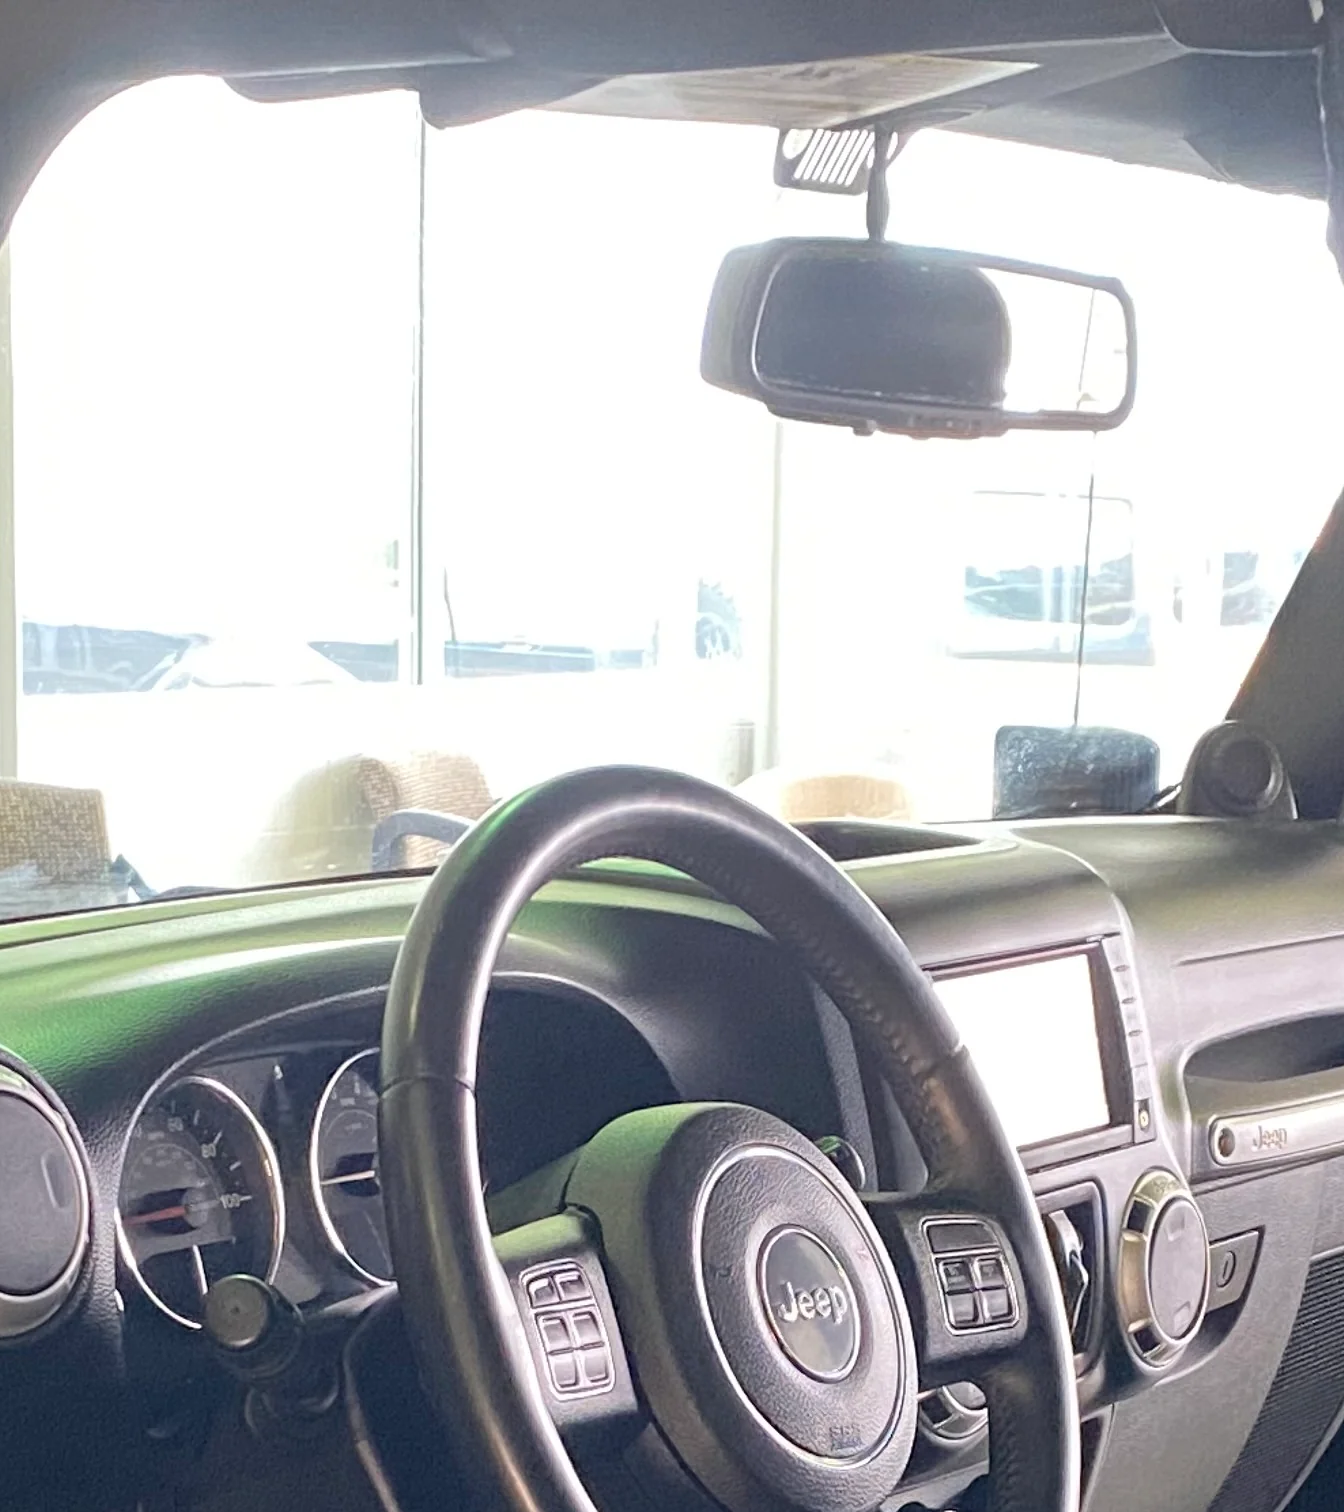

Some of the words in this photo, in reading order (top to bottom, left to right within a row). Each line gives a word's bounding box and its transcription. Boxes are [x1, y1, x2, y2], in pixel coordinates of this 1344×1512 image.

[1252, 1125, 1288, 1150] Jeep
[220, 1193, 242, 1209] 100
[778, 1281, 848, 1325] Jeep
